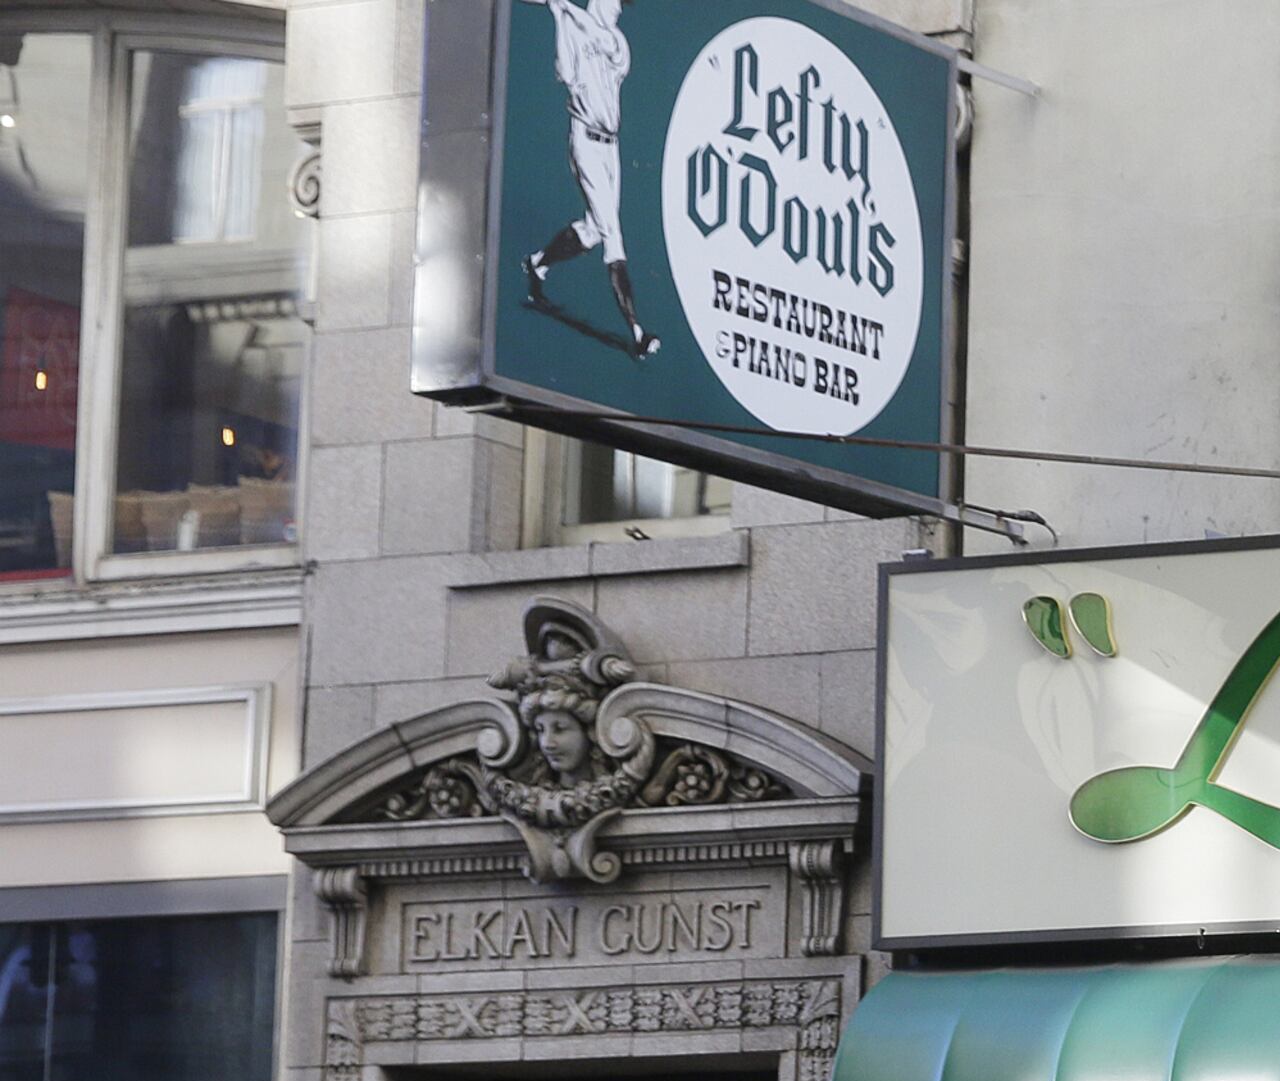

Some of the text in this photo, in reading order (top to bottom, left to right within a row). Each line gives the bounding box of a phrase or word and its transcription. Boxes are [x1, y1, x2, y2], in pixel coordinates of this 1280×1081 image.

[687, 143, 896, 298] O'Doul's
[712, 270, 884, 361] RESTAURANT
[732, 333, 806, 388] PIANO
[814, 361, 860, 406] BAR
[410, 899, 761, 962] ELKAN GUNST
